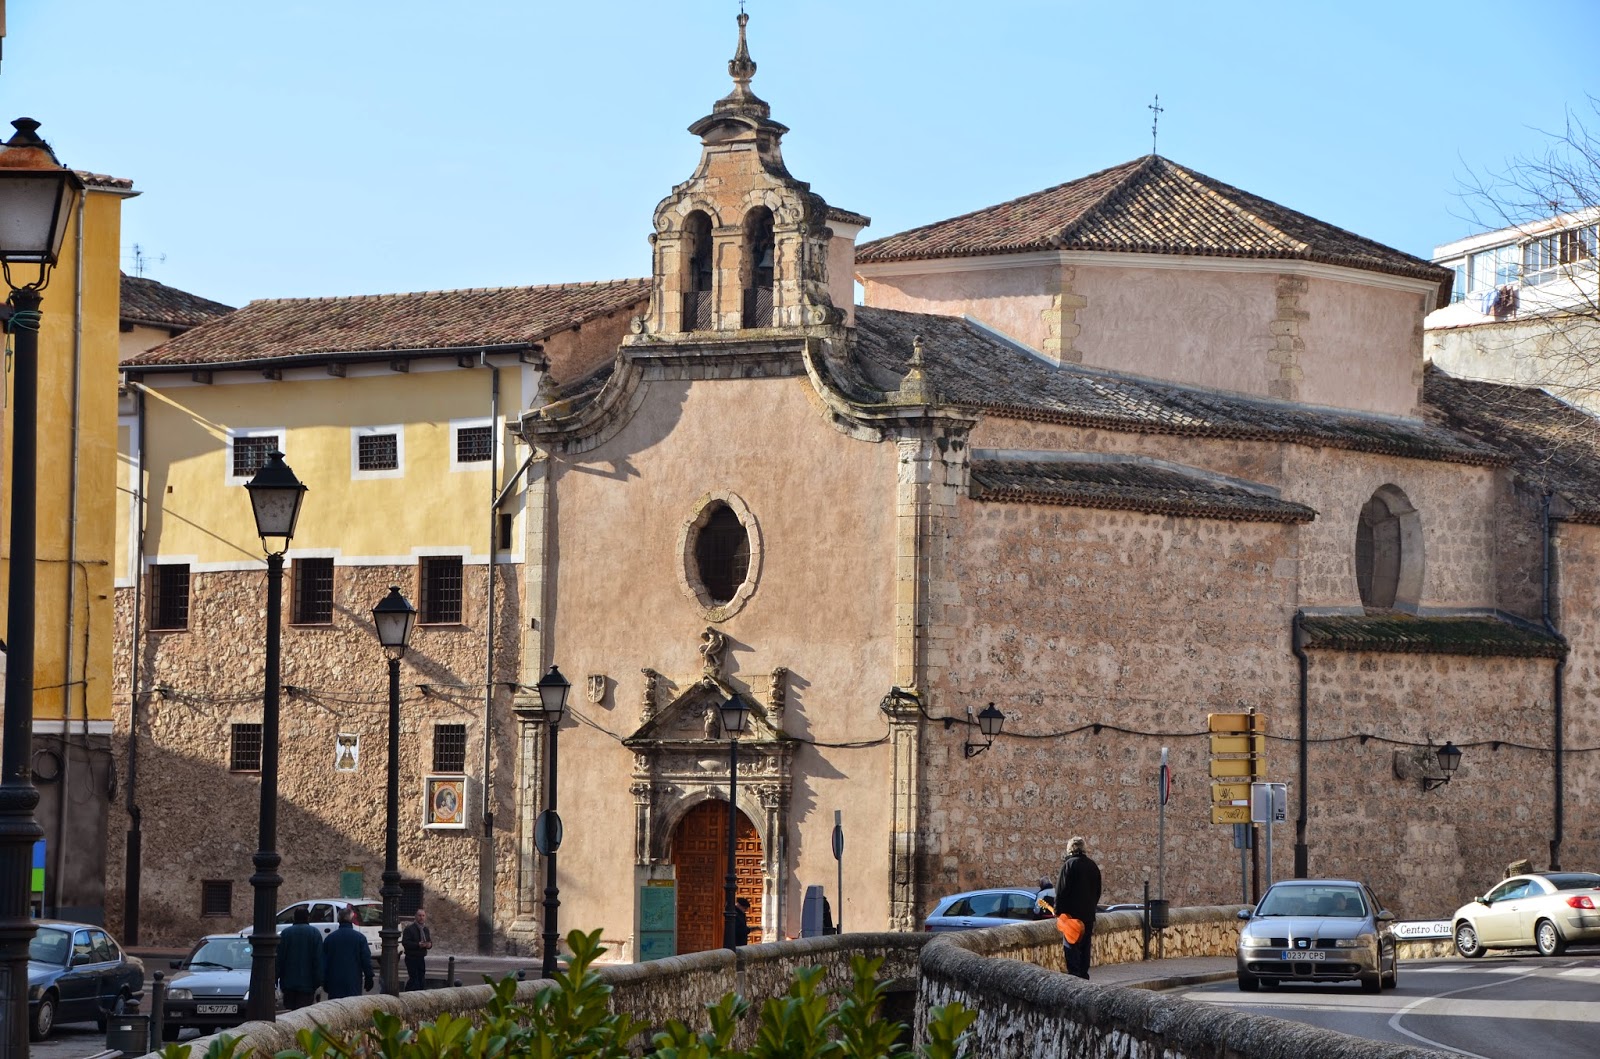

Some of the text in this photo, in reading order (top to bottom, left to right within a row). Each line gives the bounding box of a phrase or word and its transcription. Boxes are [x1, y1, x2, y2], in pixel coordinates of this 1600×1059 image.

[1400, 924, 1431, 935] Centro
[1286, 951, 1324, 960] 0237 CPS
